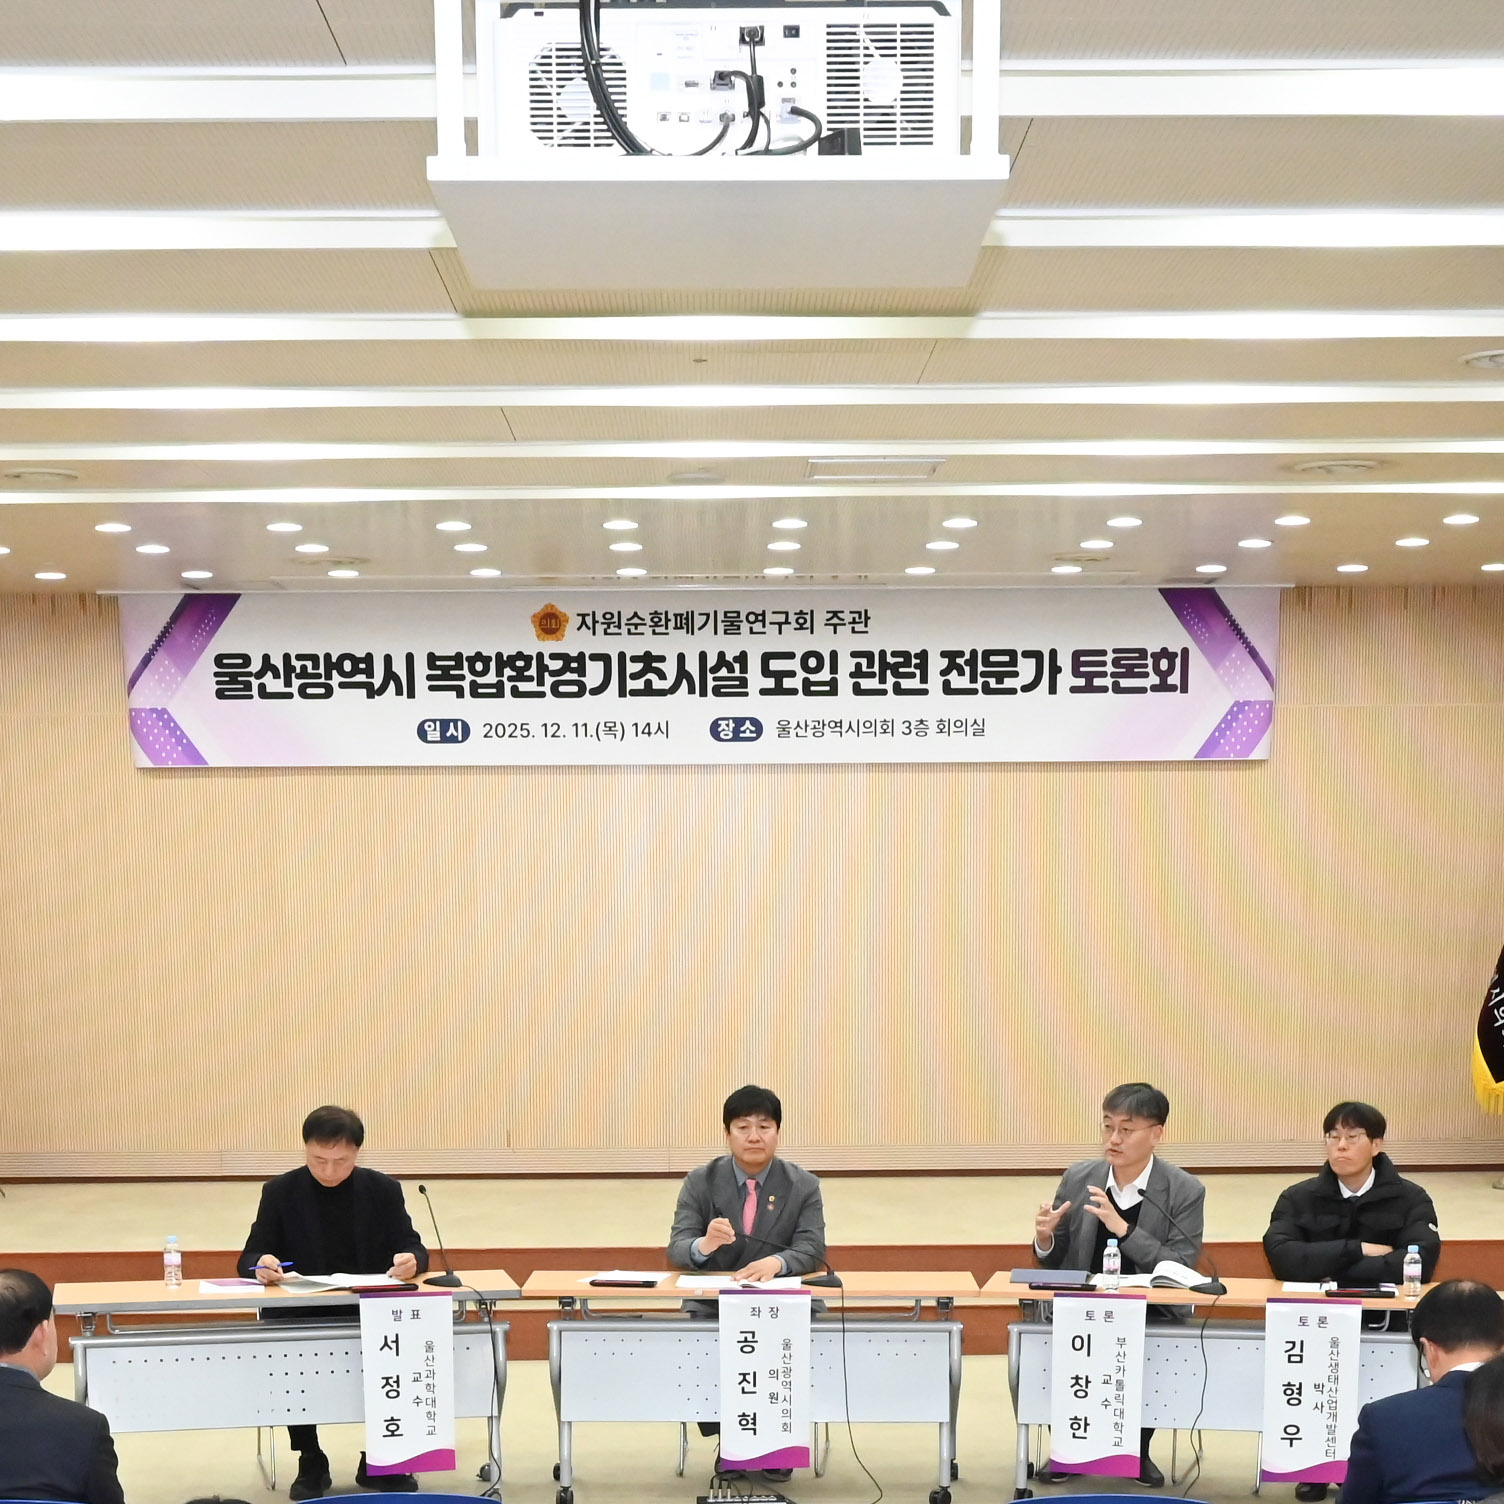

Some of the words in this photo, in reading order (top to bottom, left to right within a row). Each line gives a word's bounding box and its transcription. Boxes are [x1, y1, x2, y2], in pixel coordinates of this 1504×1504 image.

[576, 609, 815, 637] 자원순환폐기물연구회
[823, 608, 872, 635] 주관
[212, 650, 417, 701] 울산광역시
[425, 649, 751, 700] 복합환경기초시설
[758, 649, 840, 698] 도입
[848, 648, 930, 697] 관련
[939, 647, 1063, 697] 전문가
[1068, 646, 1191, 695] 토론회
[423, 720, 464, 741] 일시
[482, 722, 537, 740] 2025.
[541, 722, 567, 739] 12.
[572, 721, 626, 742] 11.(목)
[631, 719, 670, 740] 14시
[716, 718, 758, 740] 장소
[776, 718, 896, 740] 울산광역시의회
[901, 718, 930, 738] 3층
[935, 717, 986, 738] 회의실
[424, 1340, 438, 1437] 울산과학대학교
[781, 1338, 793, 1435] 울산광역시의회
[1112, 1336, 1128, 1448] 부산카톨릭대학교
[1325, 1336, 1341, 1461] 울산생태산업개발센터
